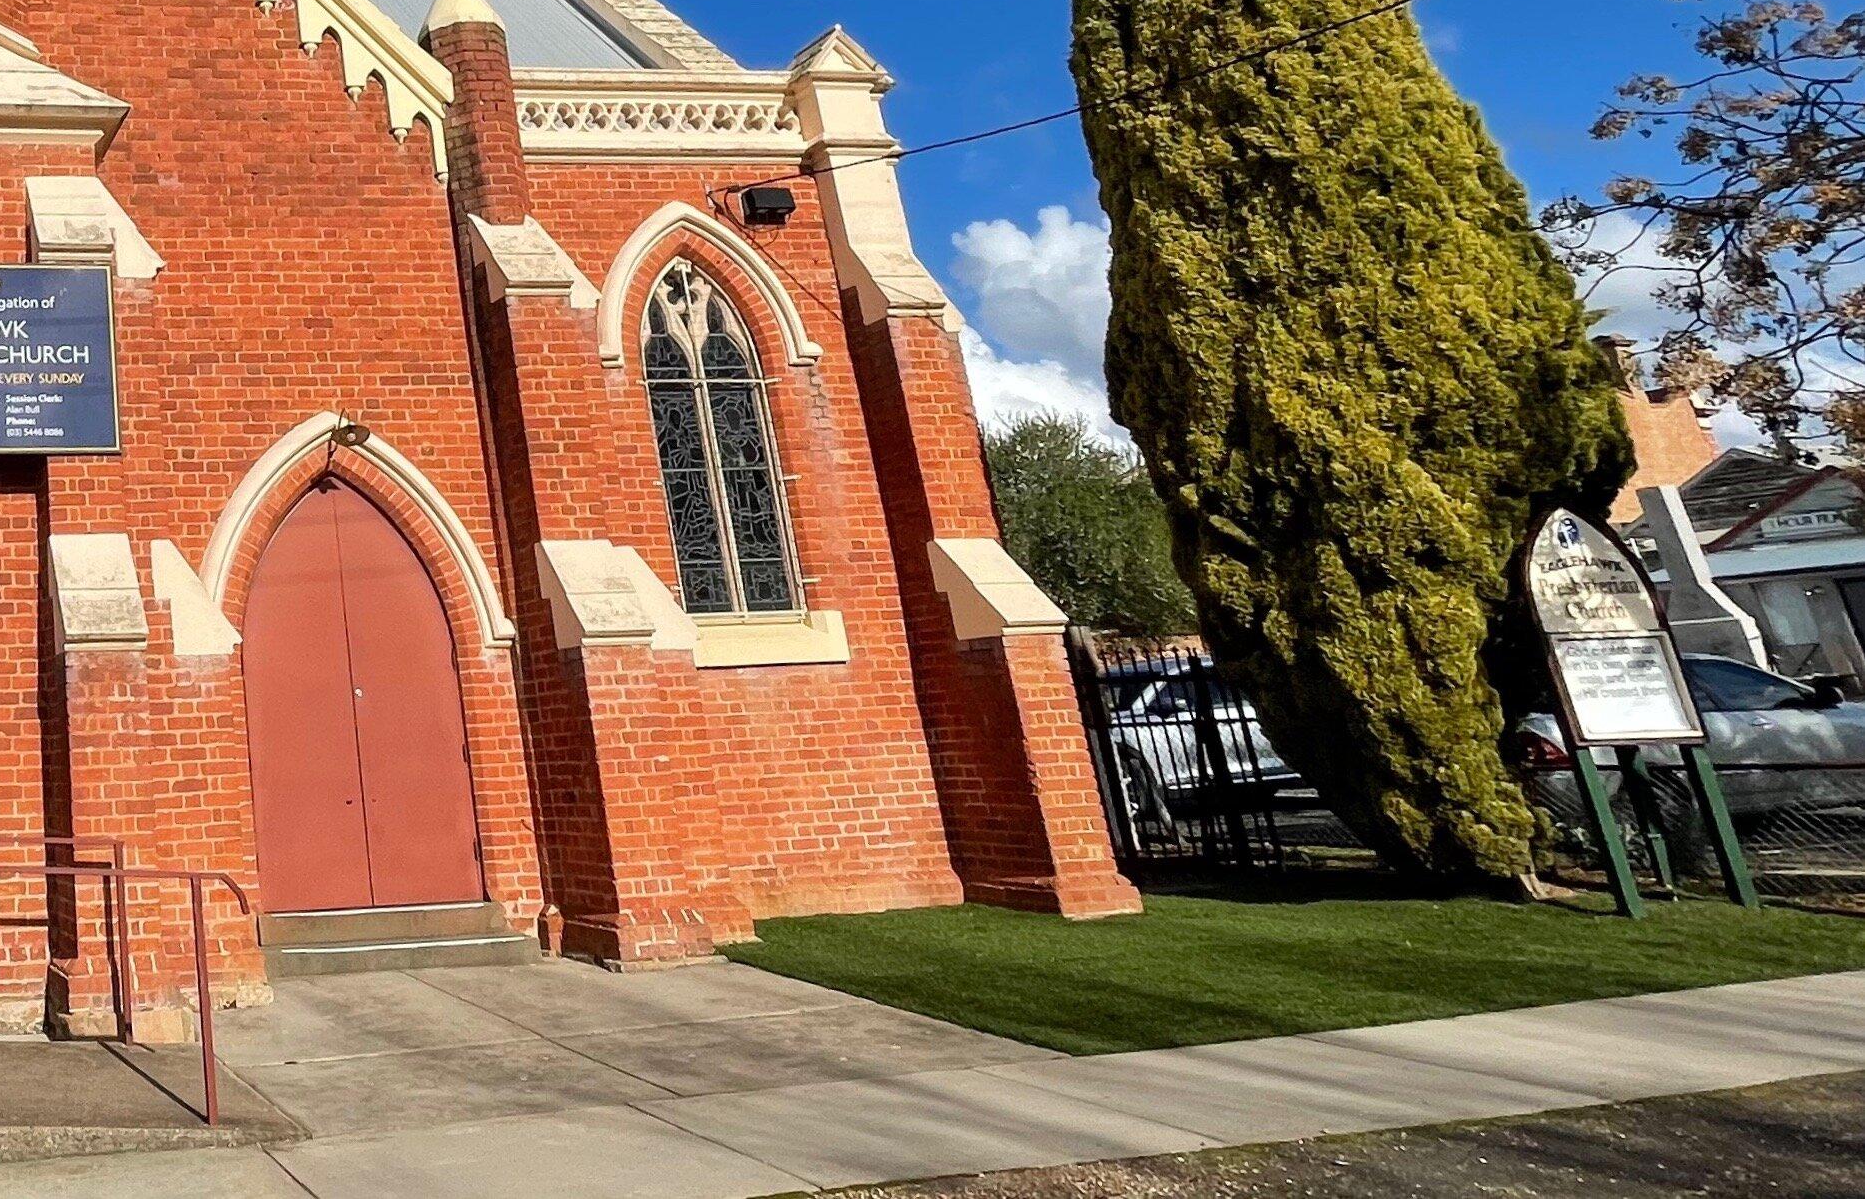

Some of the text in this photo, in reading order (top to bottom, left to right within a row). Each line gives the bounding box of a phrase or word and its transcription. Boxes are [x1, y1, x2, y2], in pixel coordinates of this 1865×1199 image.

[40, 295, 55, 308] of
[38, 373, 85, 384] SUNDAY
[5, 394, 37, 403] Session
[1539, 557, 1625, 573] EAGLEHAWK
[1566, 601, 1628, 619] Church
